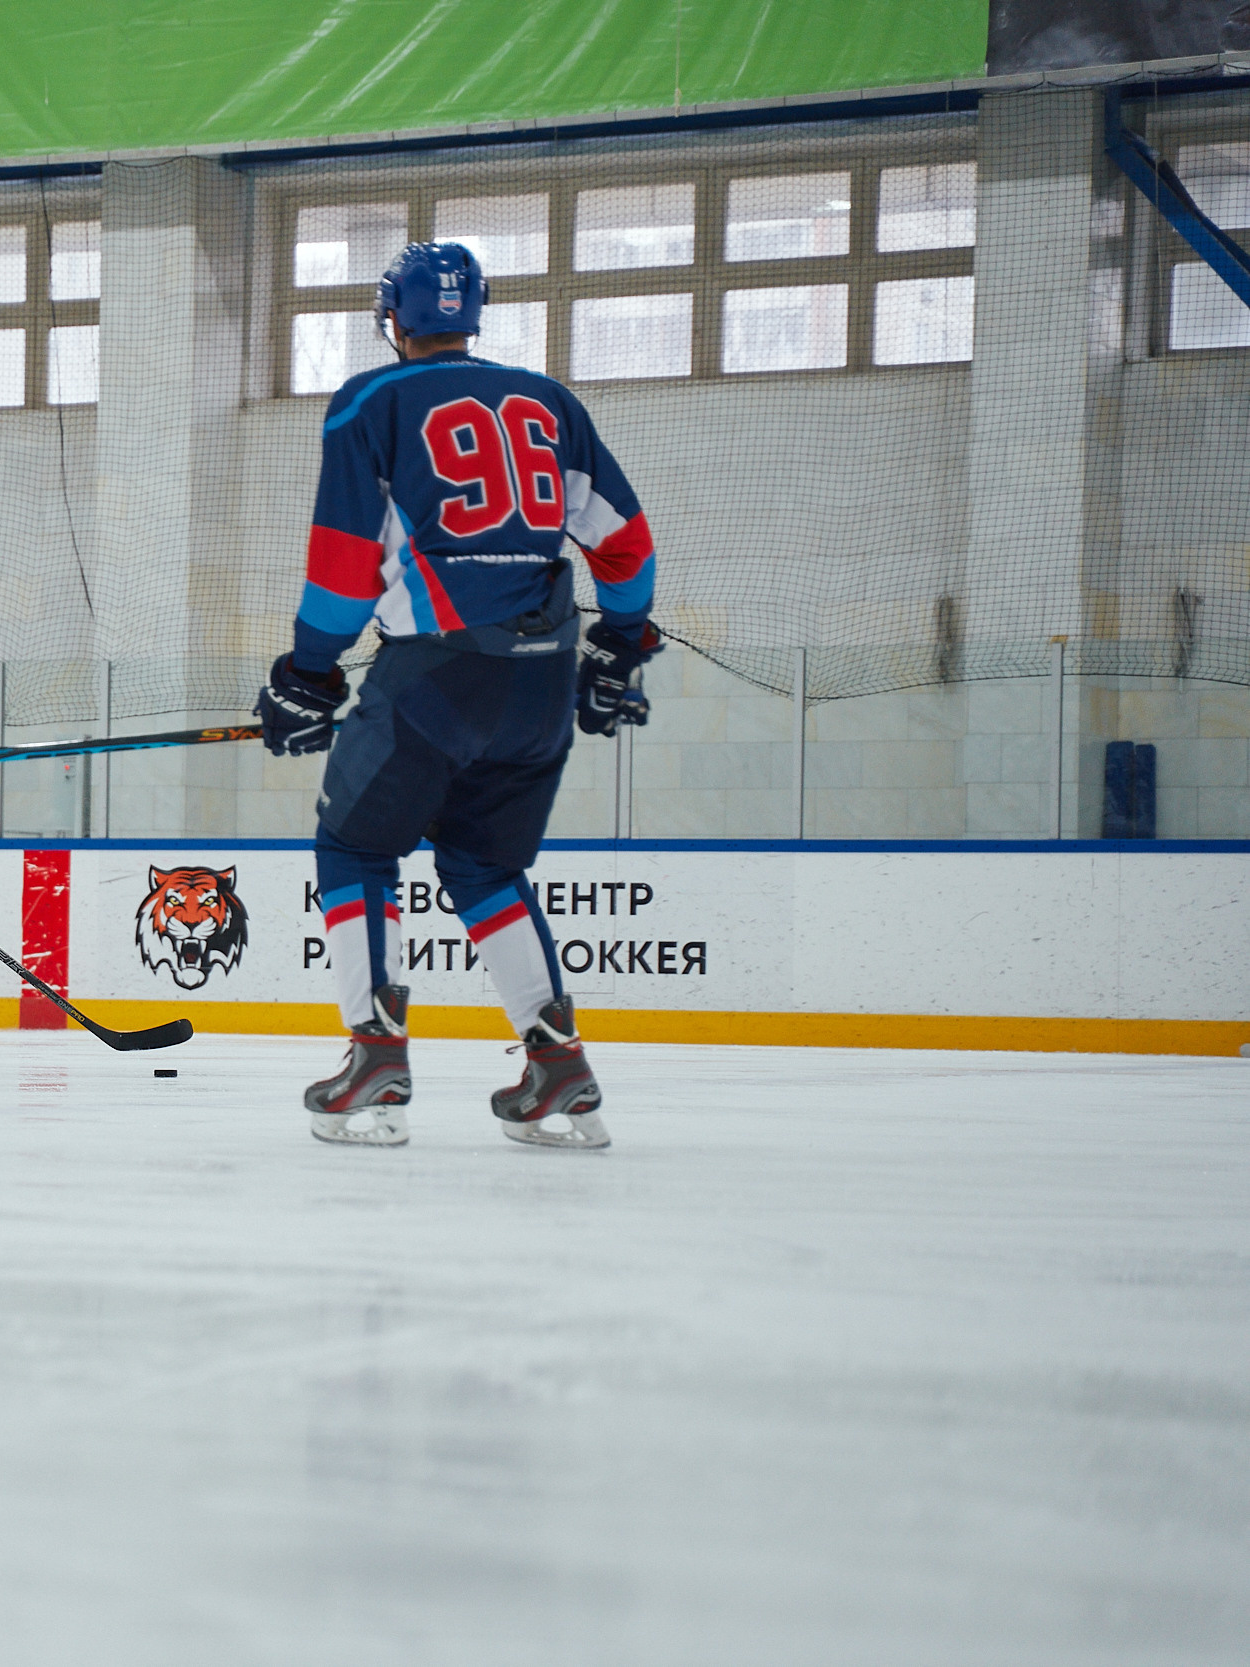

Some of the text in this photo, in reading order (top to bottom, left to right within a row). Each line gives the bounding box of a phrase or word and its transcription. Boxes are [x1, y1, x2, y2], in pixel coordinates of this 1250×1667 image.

[421, 394, 564, 538] 96
[533, 882, 653, 916] ЕНТР
[554, 939, 707, 975] ОККЕЯ
